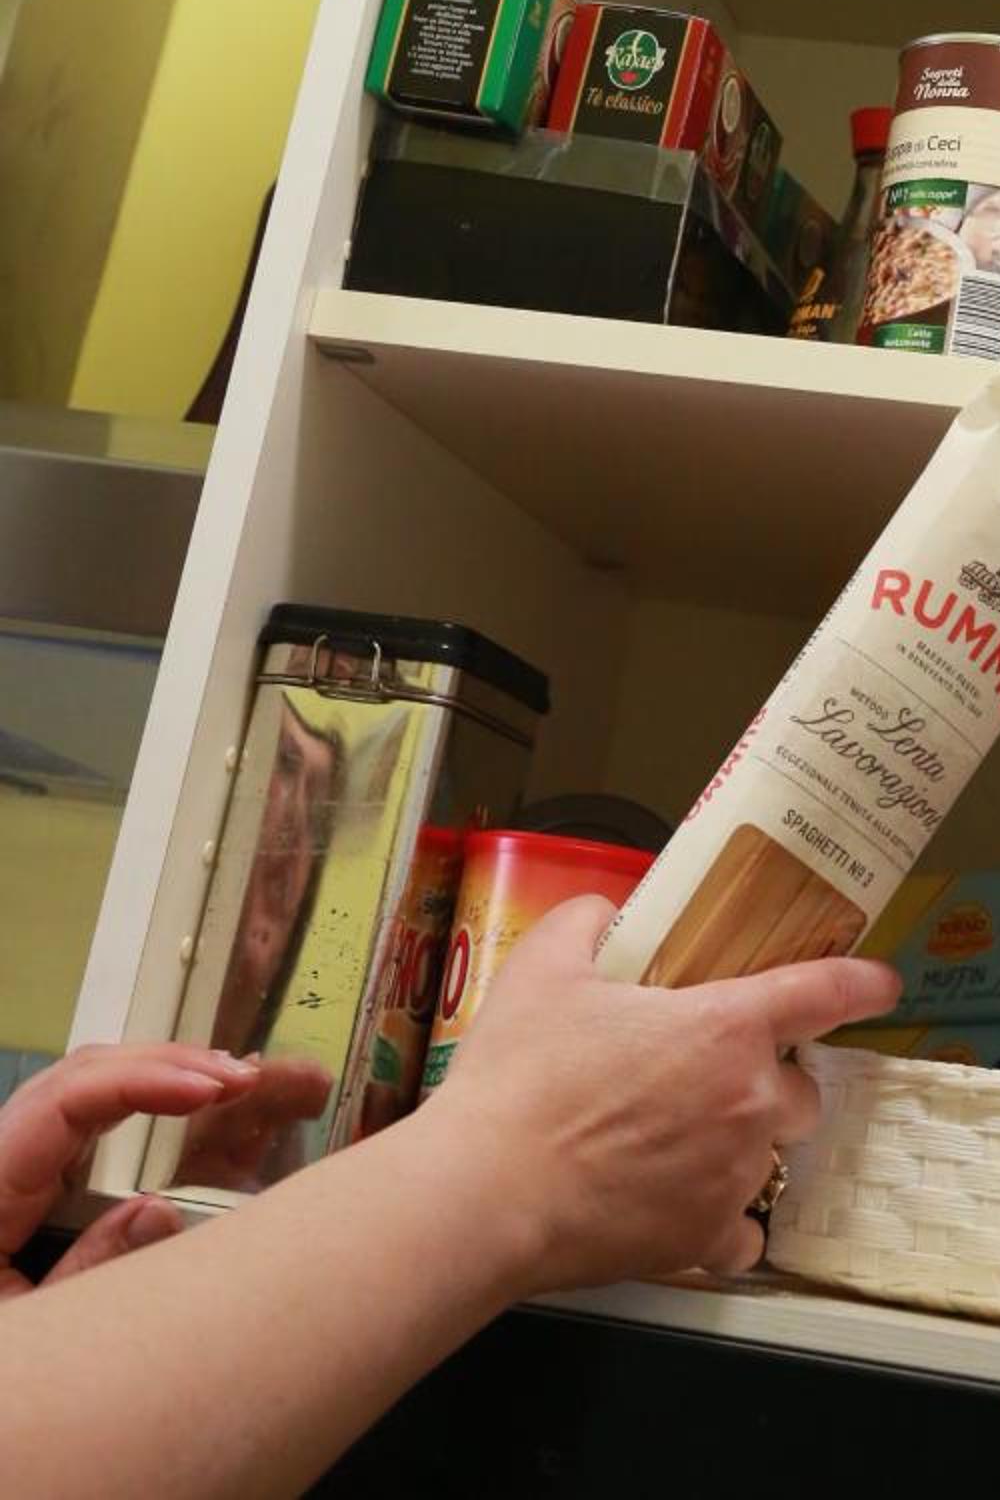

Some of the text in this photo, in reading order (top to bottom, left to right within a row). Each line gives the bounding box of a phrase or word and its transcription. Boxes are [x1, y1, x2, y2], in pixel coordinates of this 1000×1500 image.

[921, 66, 963, 82] Segreti
[913, 83, 970, 101] Nonna
[927, 135, 961, 152] Ceci
[867, 706, 945, 782] Lenta
[781, 807, 851, 868] SPAGHETTI
